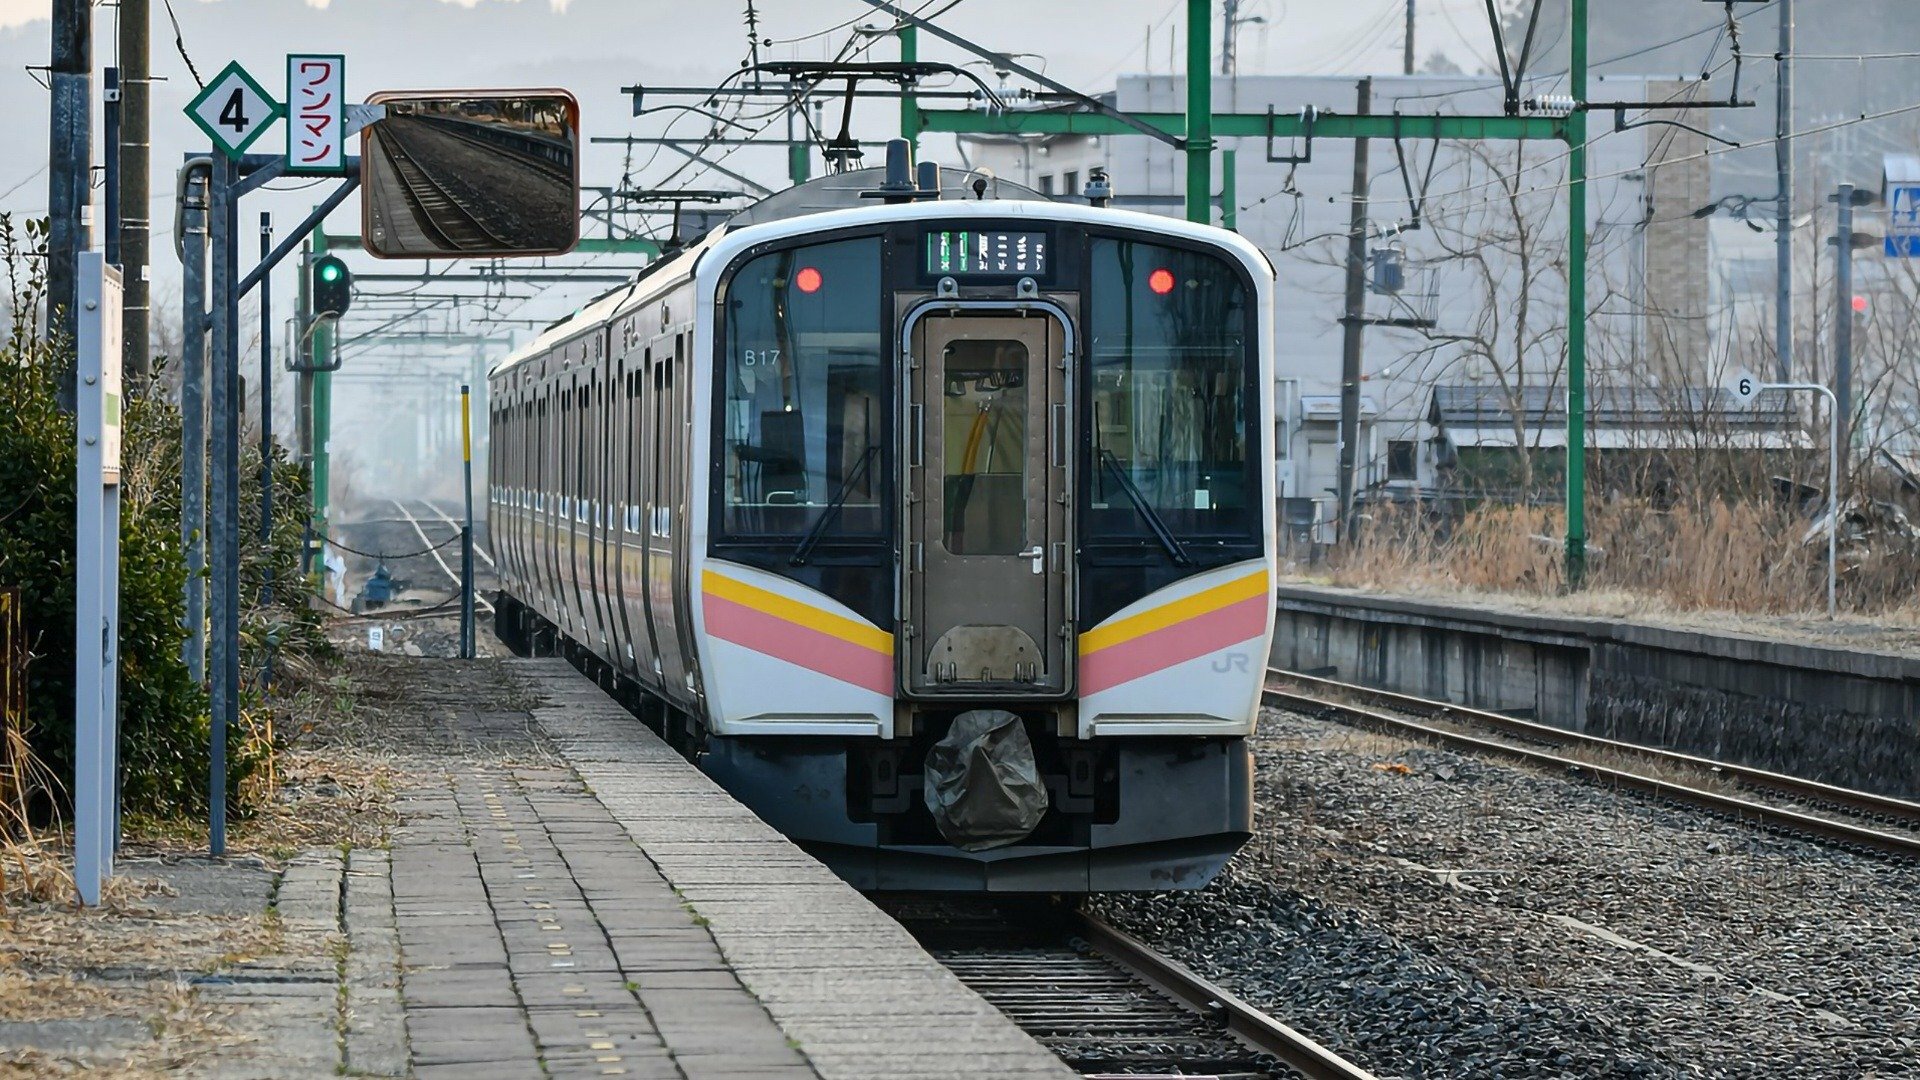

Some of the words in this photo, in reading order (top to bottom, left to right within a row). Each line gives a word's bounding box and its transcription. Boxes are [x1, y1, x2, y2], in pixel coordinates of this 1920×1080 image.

[219, 87, 249, 133] 4
[300, 62, 331, 162] ワンマン
[745, 349, 780, 366] B17
[1739, 378, 1751, 396] 6
[1211, 652, 1249, 674] JR
